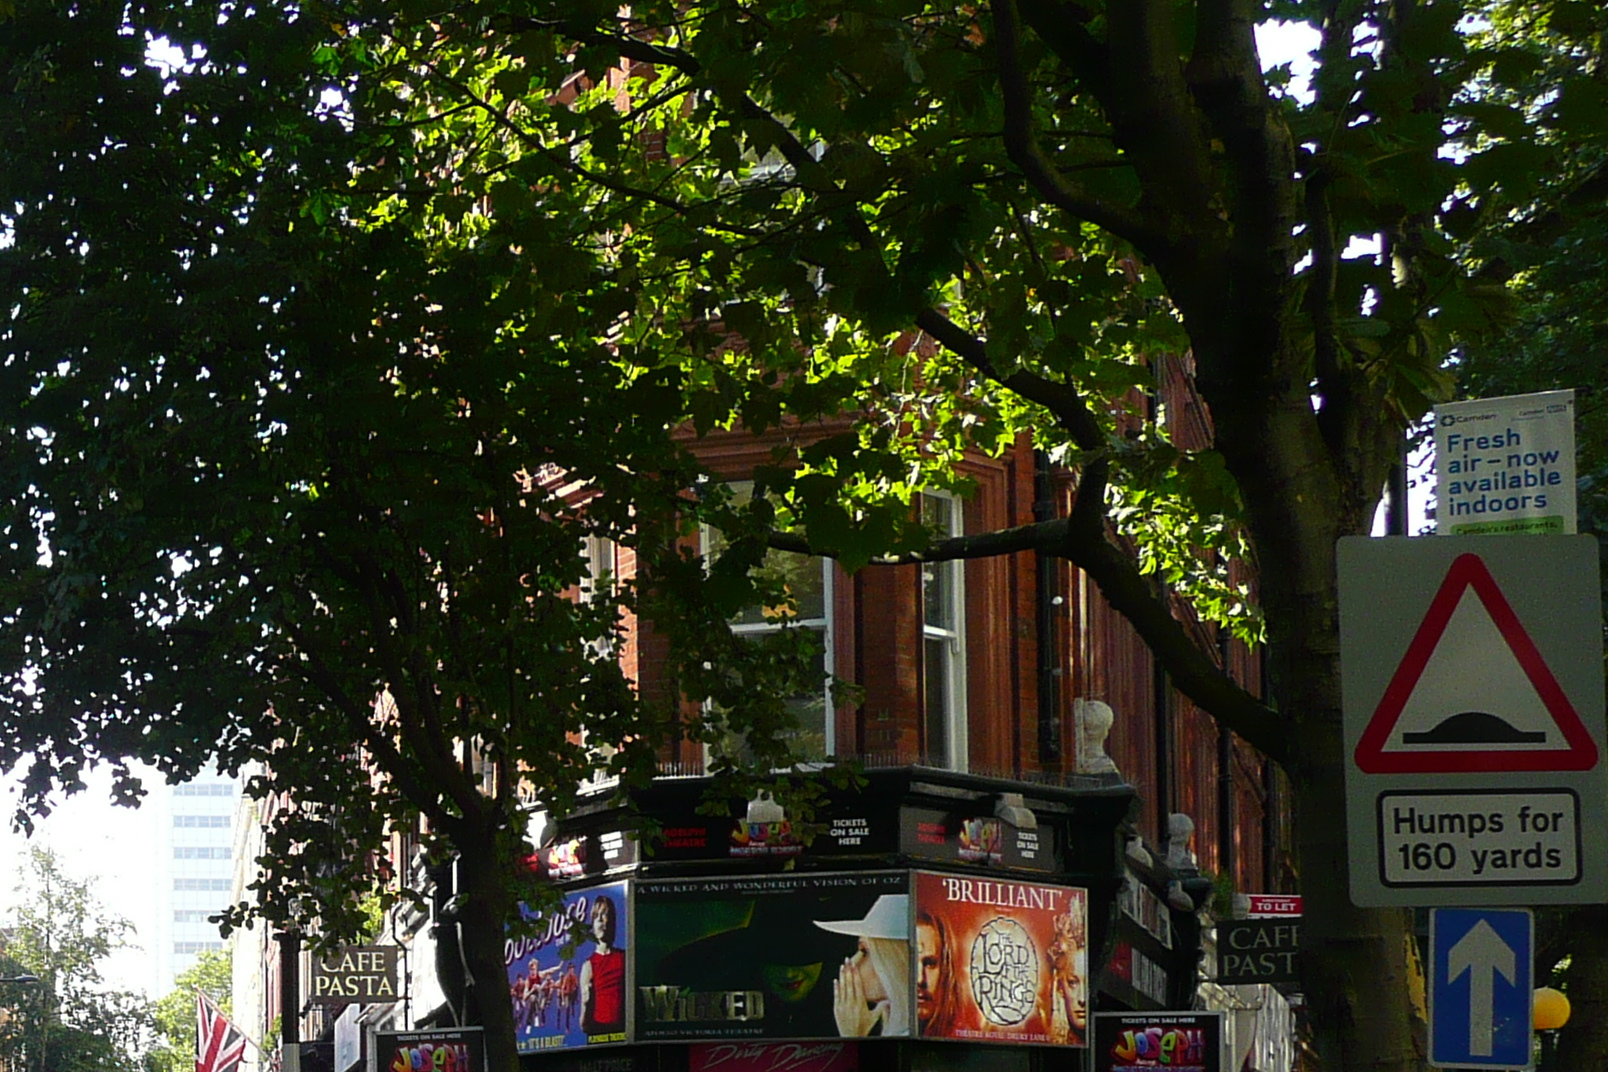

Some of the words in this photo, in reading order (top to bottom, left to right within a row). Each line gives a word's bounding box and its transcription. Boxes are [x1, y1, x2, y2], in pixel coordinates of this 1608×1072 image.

[1457, 414, 1497, 424] Camden
[1447, 428, 1521, 453] Fresh
[1448, 454, 1482, 474] air
[1507, 450, 1560, 468] now
[1448, 468, 1562, 495] available
[1449, 494, 1547, 516] indoors
[830, 828, 846, 837] ON
[848, 827, 870, 836] SALE
[832, 818, 867, 828] TICKETS
[1393, 806, 1504, 838] Humps
[1518, 805, 1563, 832] for
[838, 837, 862, 846] HERE
[1398, 842, 1457, 870] 160
[1470, 842, 1561, 874] yards
[637, 886, 646, 894] A
[650, 884, 698, 894] WICKED
[702, 883, 729, 892] AND
[732, 879, 808, 891] WONDERFUL
[813, 878, 857, 888] VISION
[861, 877, 877, 886] OF
[883, 876, 901, 885] OZ
[1256, 902, 1273, 911] TO
[1274, 902, 1297, 911] LET
[320, 951, 386, 973] CAFE
[979, 934, 1029, 974] LORD
[314, 976, 395, 996] PASTA
[978, 975, 1036, 1005] RINGS
[955, 1029, 984, 1038] THEATRE
[700, 1043, 768, 1071] Dirty
